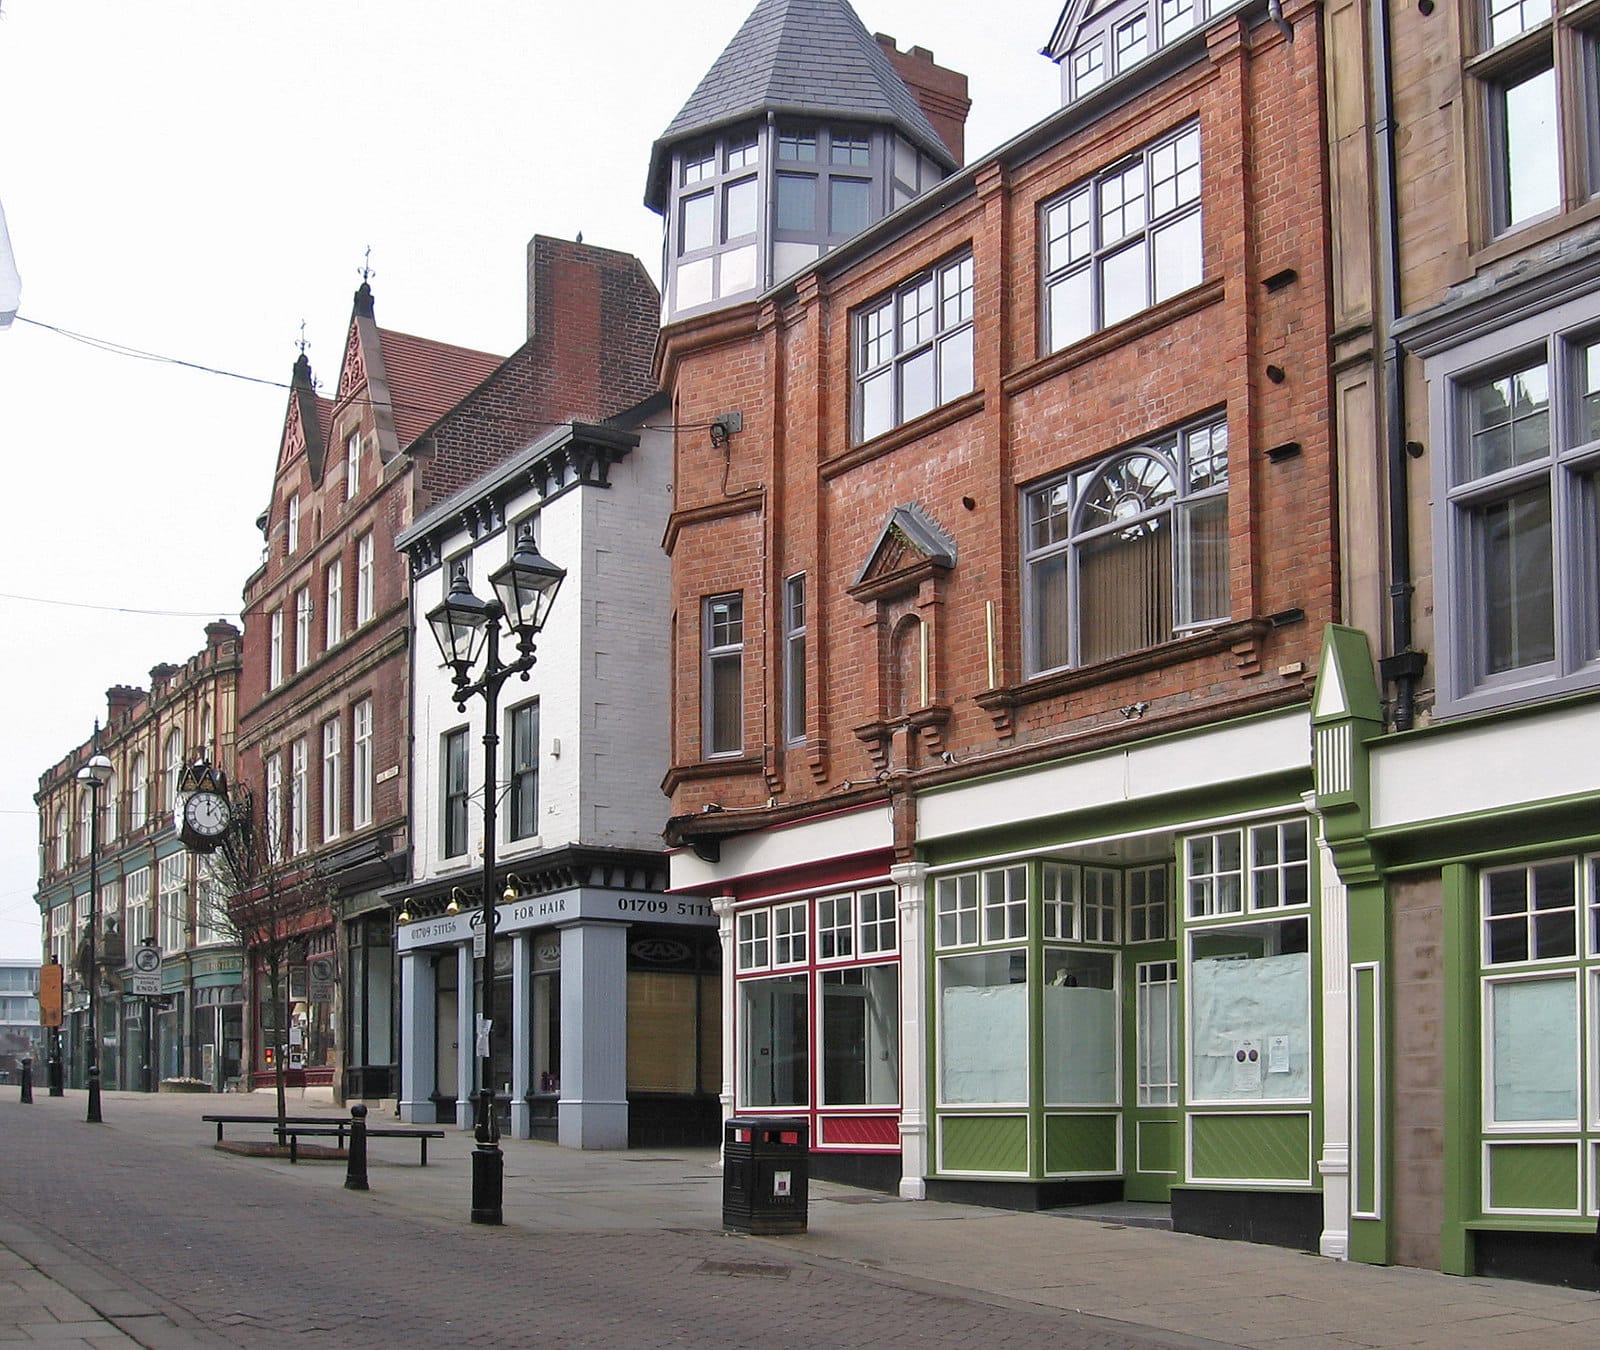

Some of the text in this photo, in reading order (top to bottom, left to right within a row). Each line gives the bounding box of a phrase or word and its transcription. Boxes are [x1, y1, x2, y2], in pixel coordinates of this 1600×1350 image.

[514, 906, 534, 920] FOR
[540, 899, 566, 915] HAIR
[617, 898, 719, 917] 01709 5111
[411, 927, 431, 940] 01709
